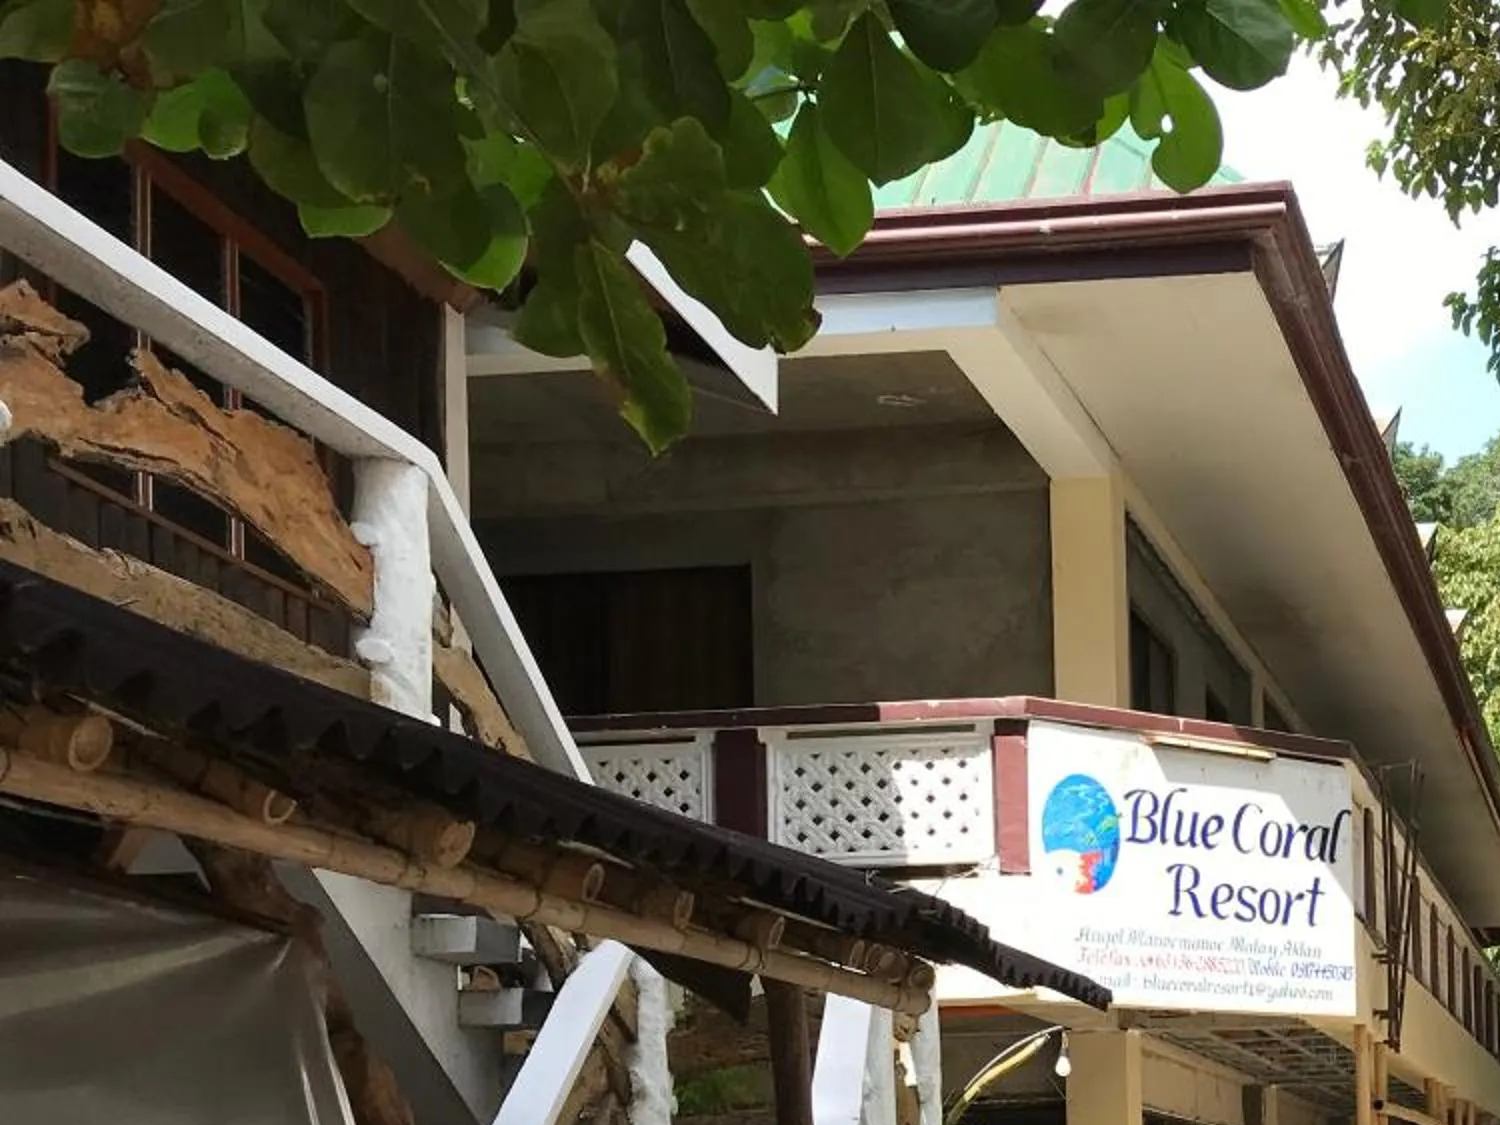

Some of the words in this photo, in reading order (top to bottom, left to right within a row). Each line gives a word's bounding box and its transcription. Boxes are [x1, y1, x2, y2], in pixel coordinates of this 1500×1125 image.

[1123, 788, 1225, 850] Blue
[1232, 802, 1352, 864] Coral
[1166, 862, 1326, 927] Resort
